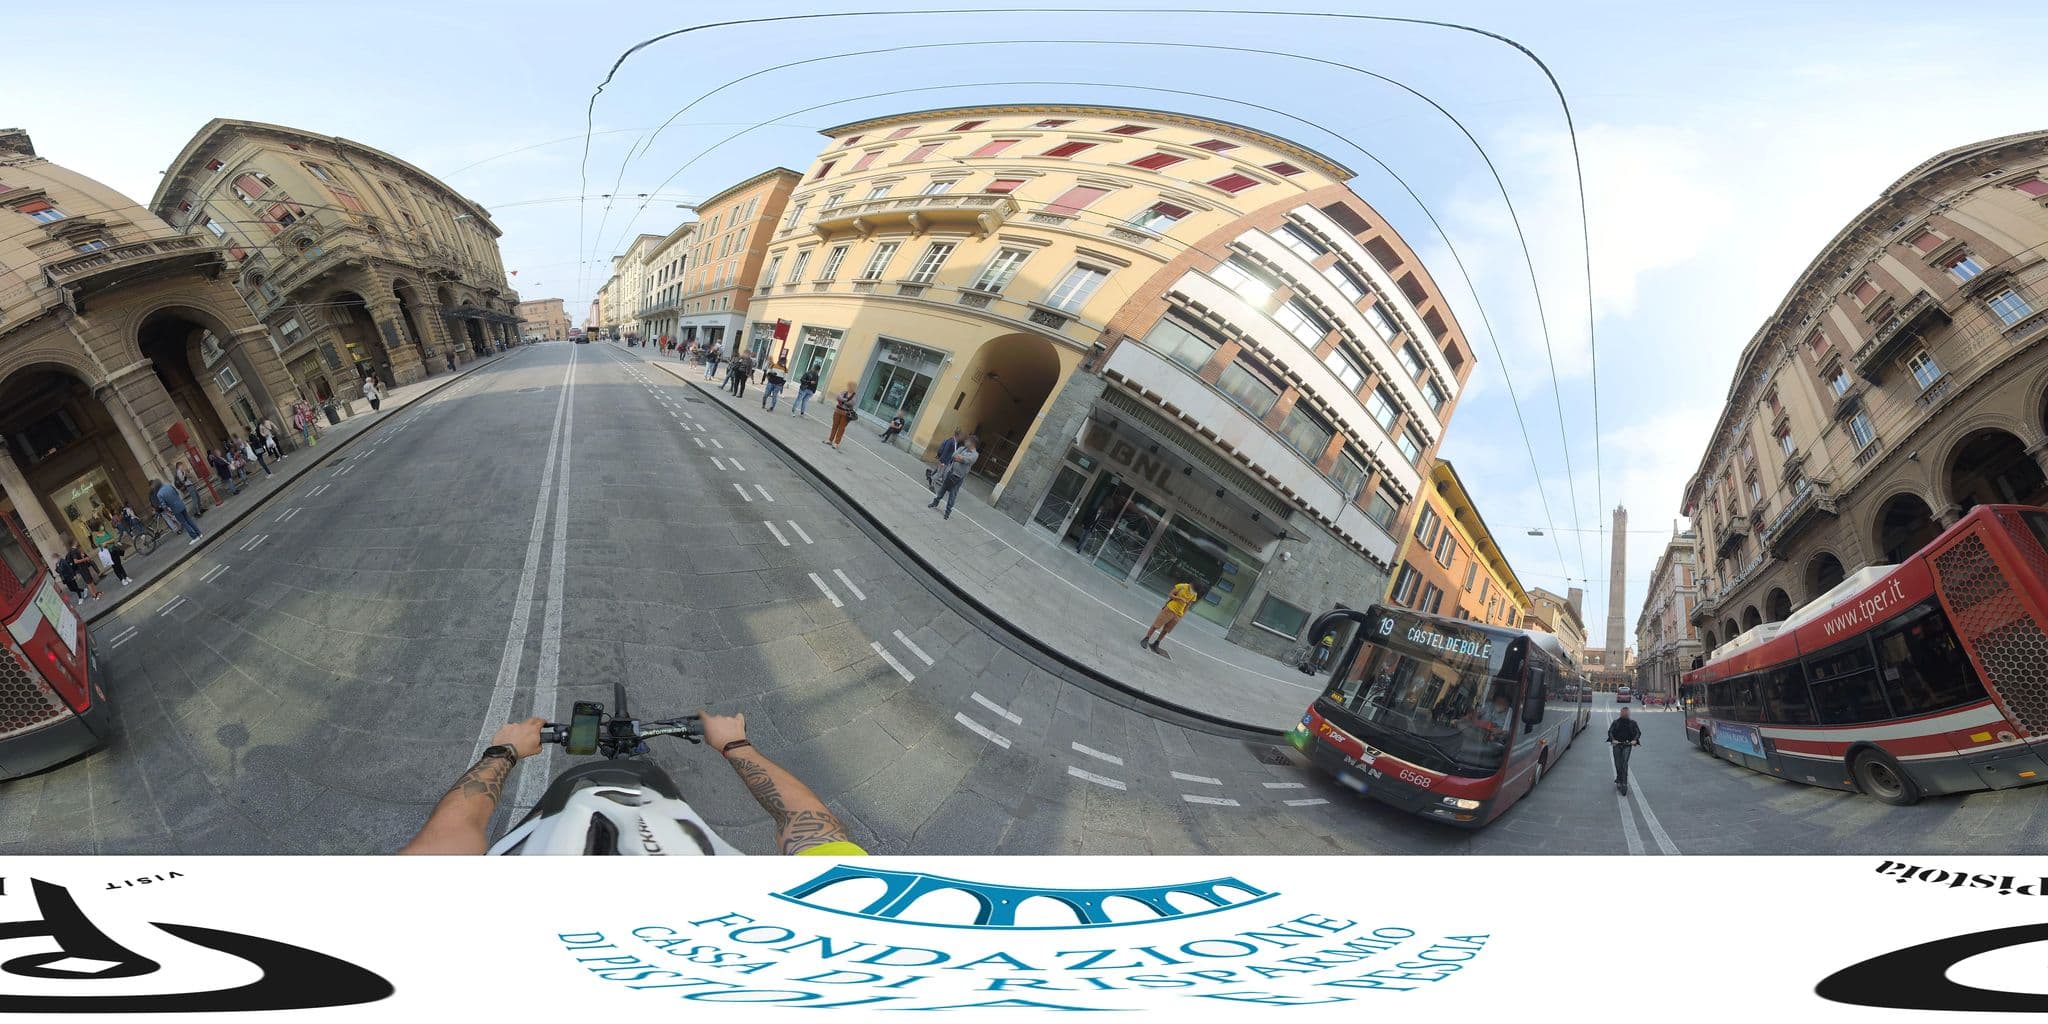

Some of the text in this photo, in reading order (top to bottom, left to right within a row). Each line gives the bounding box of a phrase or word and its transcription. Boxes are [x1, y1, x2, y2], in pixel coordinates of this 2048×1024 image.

[1109, 439, 1174, 496] BNL
[1823, 578, 1905, 636] www.tper.it
[1378, 617, 1395, 636] 19
[1344, 755, 1383, 779] MAN
[1399, 768, 1432, 788] 6568
